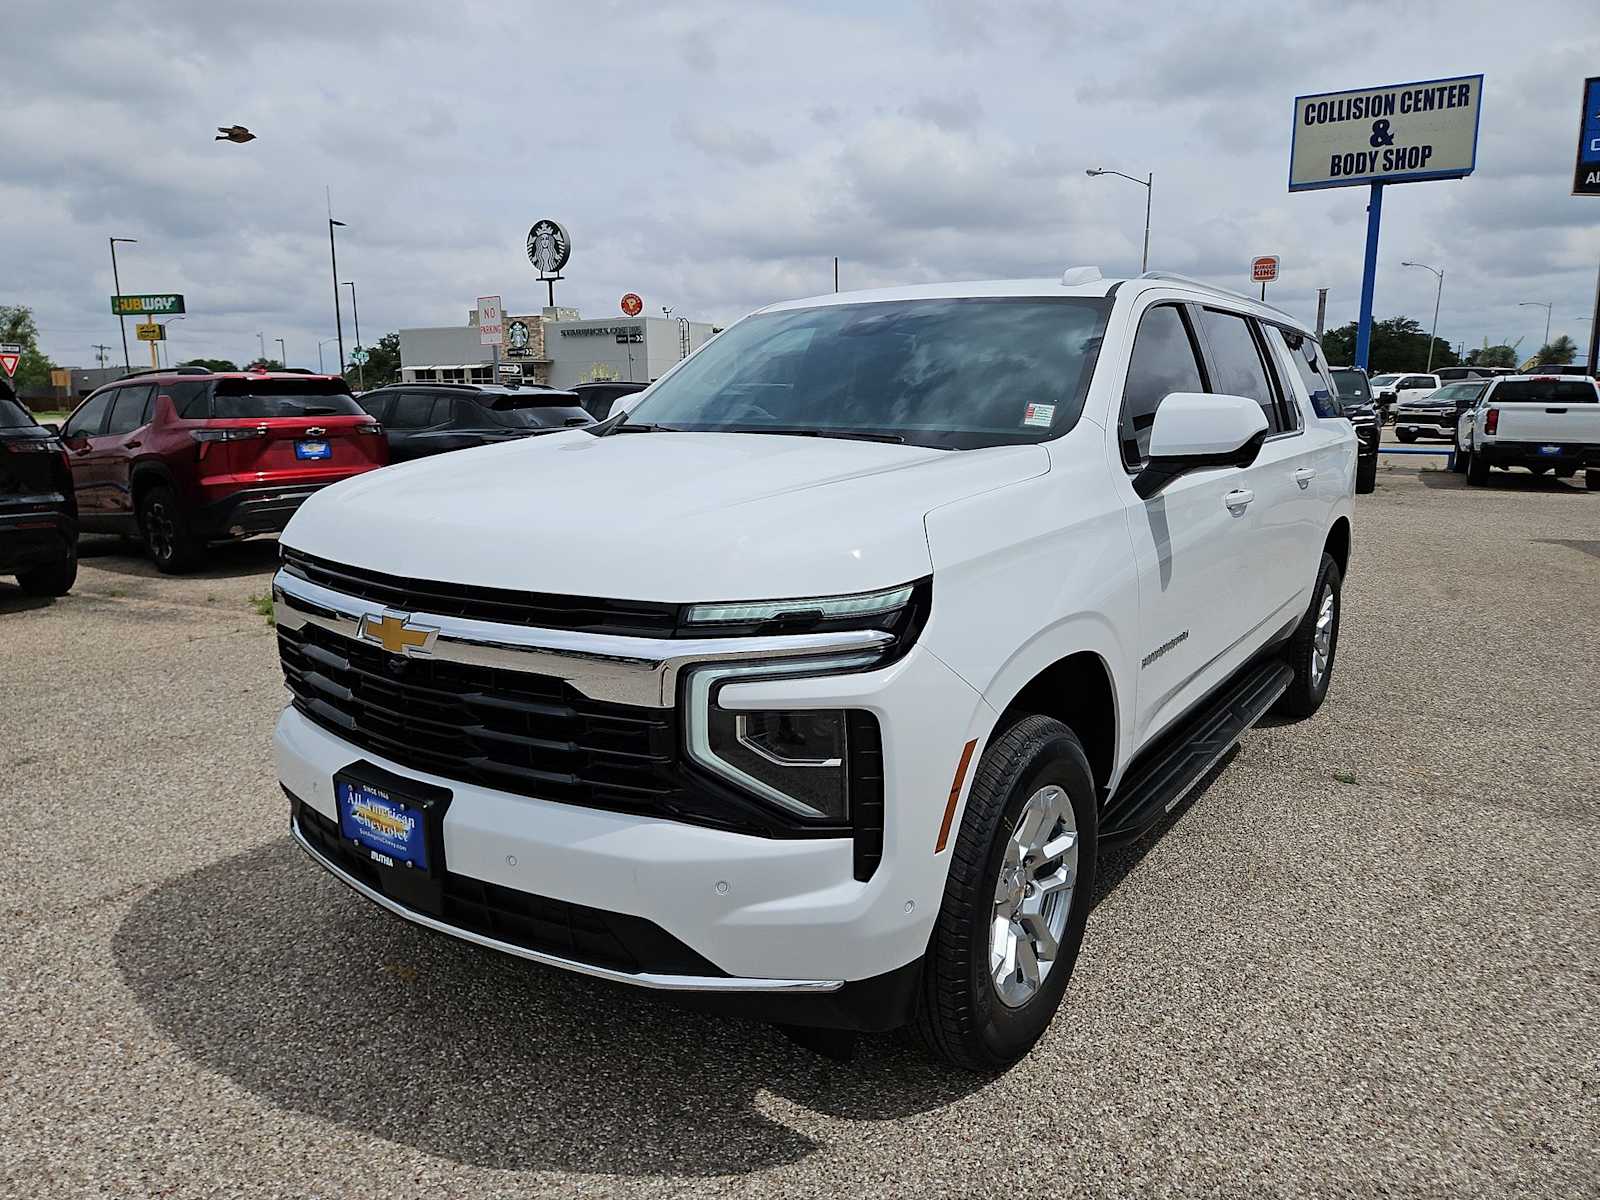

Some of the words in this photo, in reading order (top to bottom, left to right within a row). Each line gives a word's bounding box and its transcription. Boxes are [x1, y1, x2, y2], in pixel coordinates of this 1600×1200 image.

[1304, 93, 1395, 126] COLLISION
[1400, 84, 1470, 114] CENTER
[1369, 118, 1394, 147] &
[1330, 150, 1379, 177] BODY
[1382, 145, 1432, 171] SHOP
[484, 307, 496, 320] NO
[480, 325, 502, 334] PARKING
[356, 812, 409, 842] Chevrolet
[366, 798, 415, 828] American
